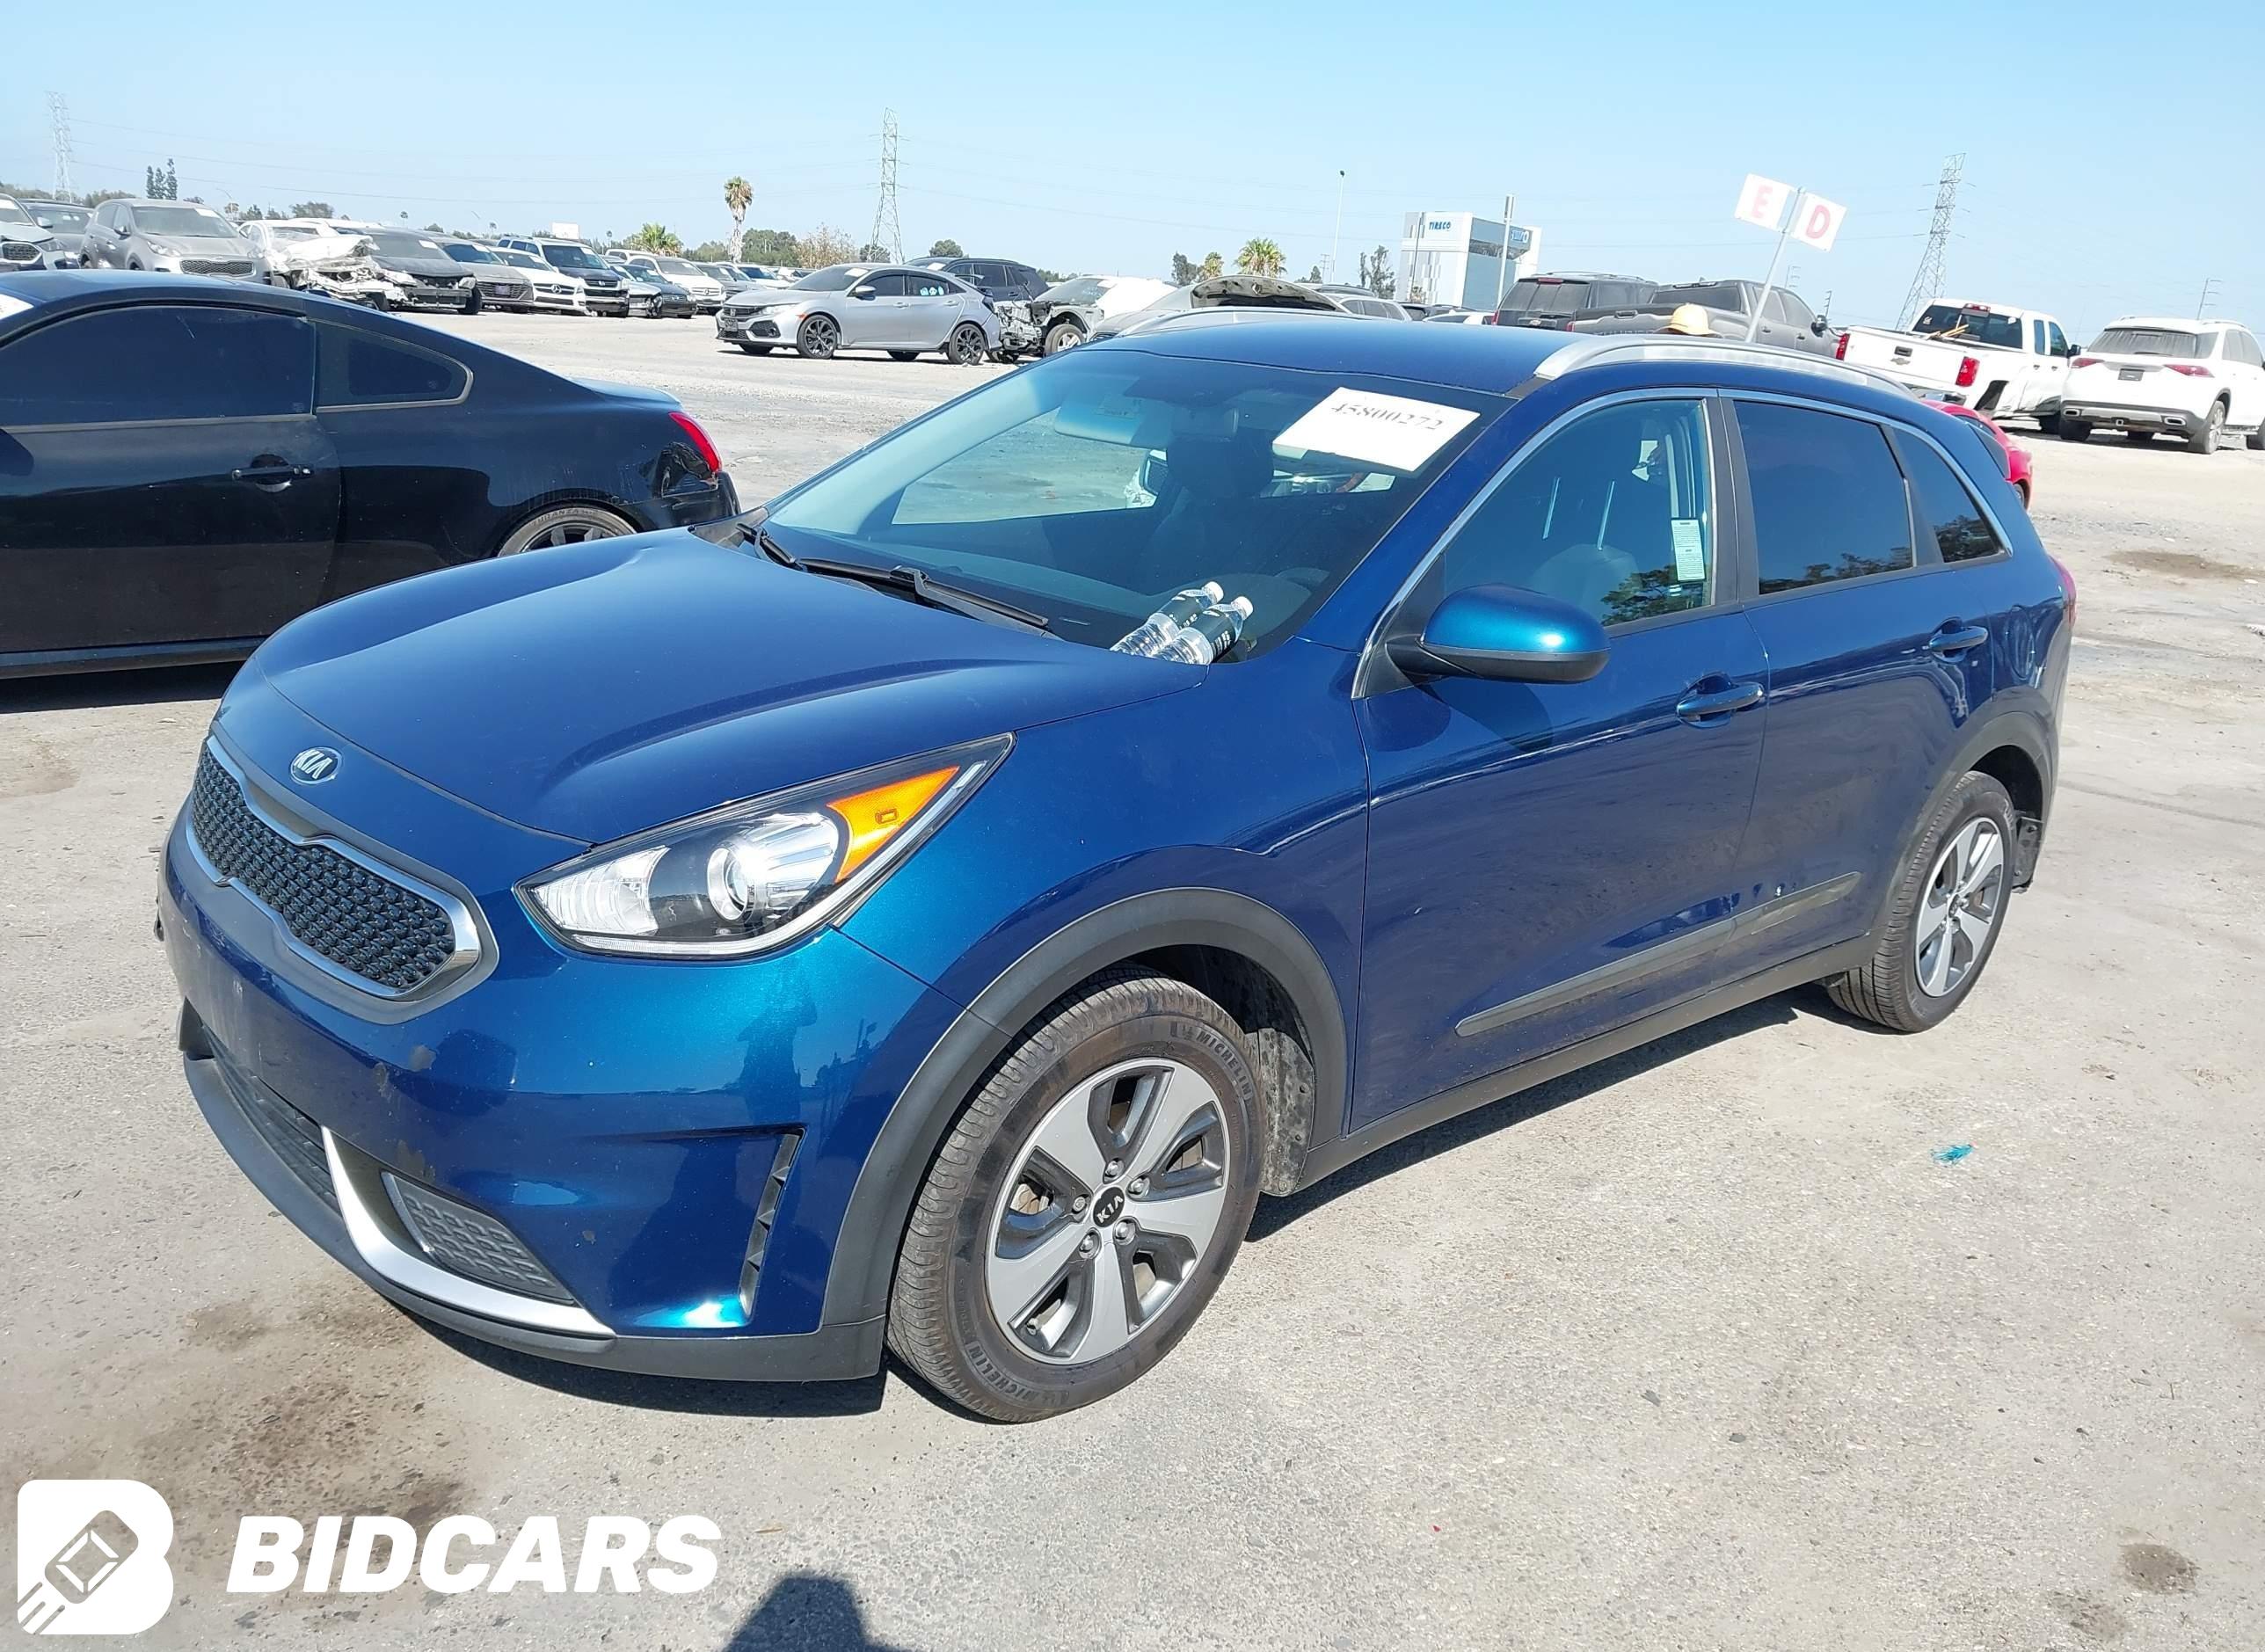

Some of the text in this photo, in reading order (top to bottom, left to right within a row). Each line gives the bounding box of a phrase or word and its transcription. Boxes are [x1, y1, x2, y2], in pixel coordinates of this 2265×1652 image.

[1752, 185, 1773, 218] E
[1805, 204, 1831, 239] D
[1330, 402, 1444, 431] 45800272
[1195, 1030, 1253, 1096] MICHELIN
[1096, 1195, 1124, 1224] KIA
[968, 1345, 1040, 1402] MICHELIN
